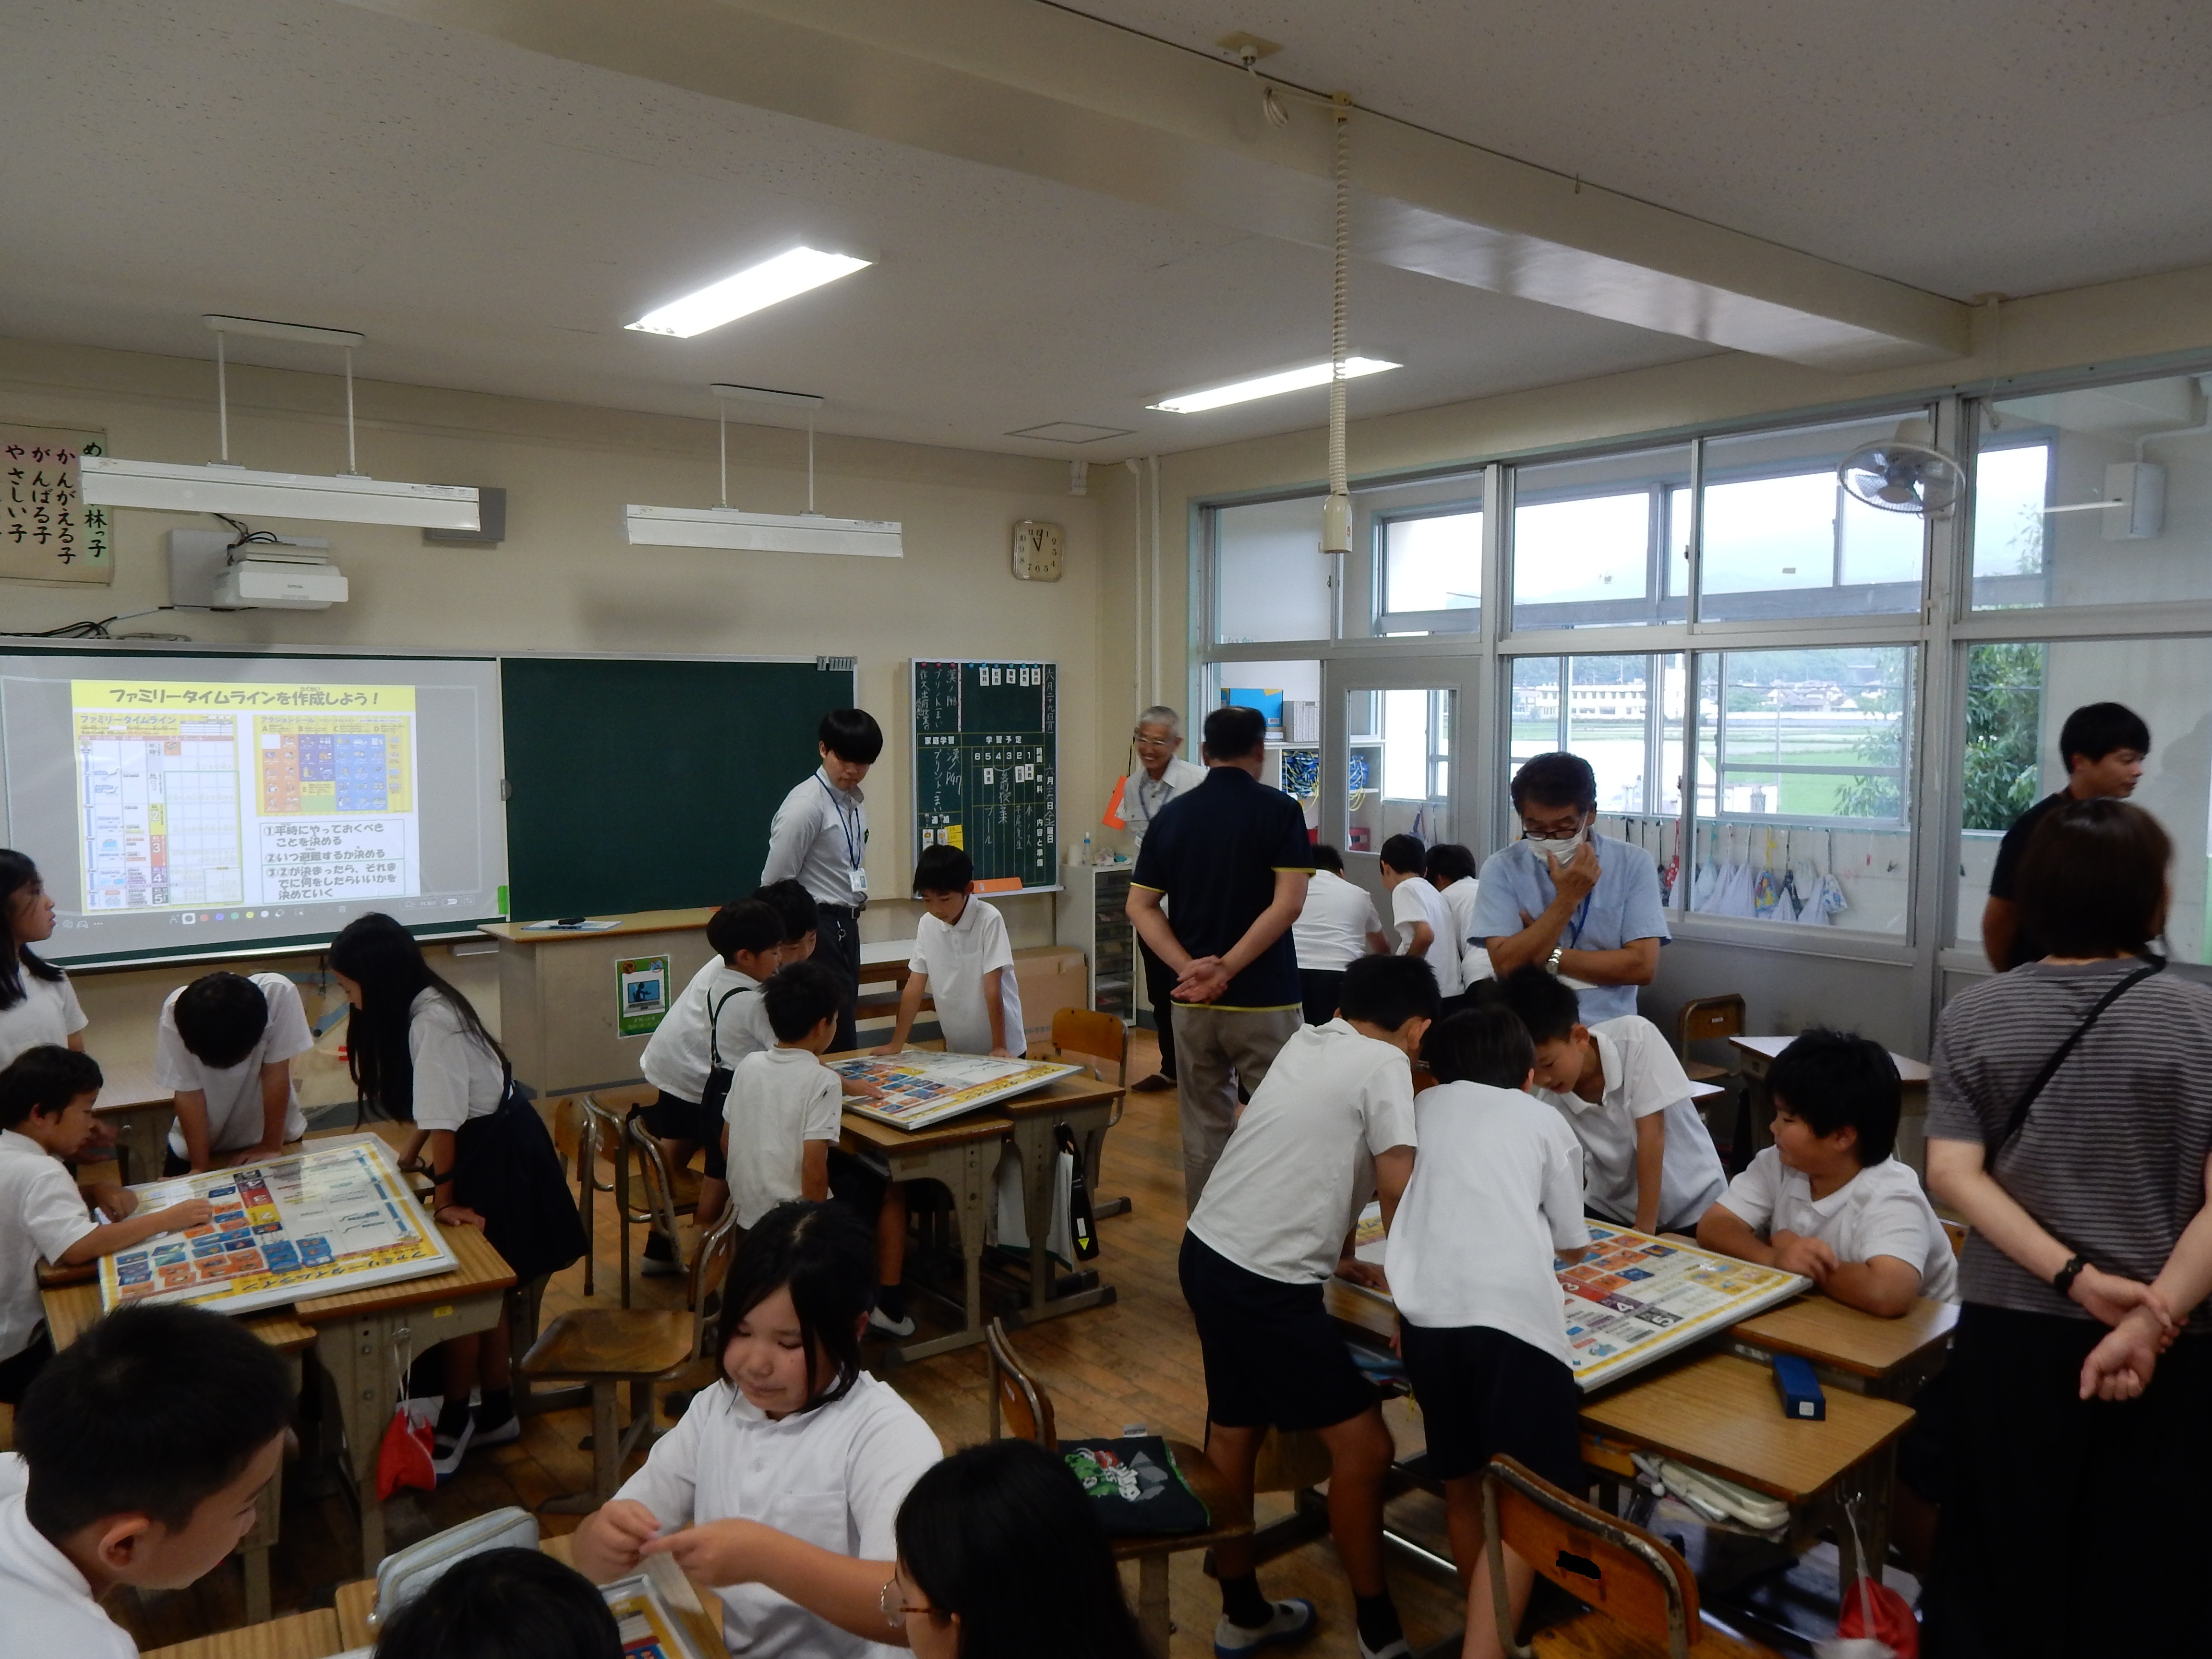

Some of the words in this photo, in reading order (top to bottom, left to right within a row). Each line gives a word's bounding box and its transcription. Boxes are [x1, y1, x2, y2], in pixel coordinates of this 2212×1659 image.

[5, 445, 27, 543] やさしい子
[32, 446, 53, 544] がんばる子
[57, 448, 76, 565] かんがえる子
[109, 688, 379, 706] ファミリータイムラインを作成しよう！
[80, 715, 177, 724] ファミリータイムライン
[986, 735, 1022, 744] 学習予定
[974, 752, 981, 760] 6
[985, 752, 991, 760] 5
[996, 752, 1001, 760] 4
[1006, 752, 1012, 760] 3
[1016, 751, 1022, 759] 2
[1027, 751, 1031, 759] 1
[152, 812, 159, 821] 2
[276, 836, 342, 847] ことを決める
[153, 843, 161, 853] 3
[153, 873, 162, 882] 4
[278, 888, 333, 900] 決めていく
[154, 894, 163, 904] 5
[1616, 1301, 1635, 1312] 4
[1651, 1314, 1674, 1326] 5
